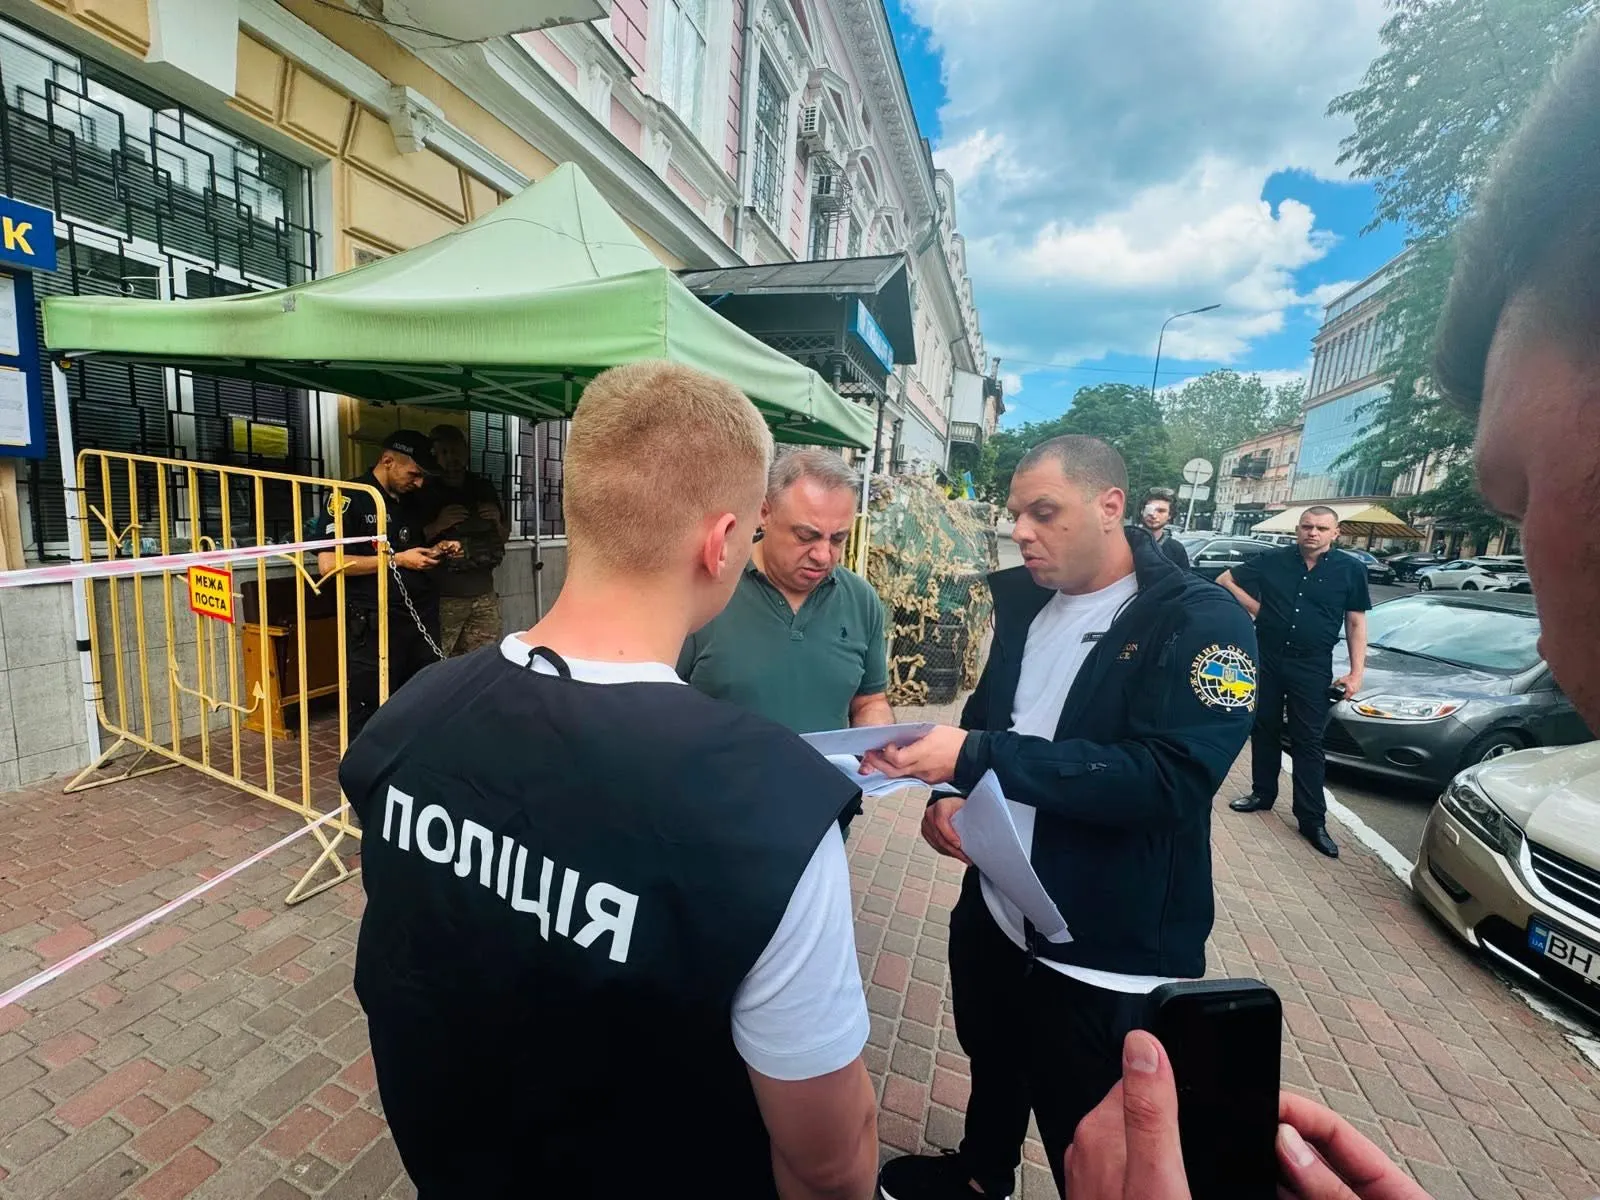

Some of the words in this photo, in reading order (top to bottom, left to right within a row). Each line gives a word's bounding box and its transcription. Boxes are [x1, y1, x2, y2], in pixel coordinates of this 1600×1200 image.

[195, 574, 224, 592] МЕЖА
[195, 591, 227, 611] ПОСТА
[382, 784, 640, 964] ПОЛІЦІЯ
